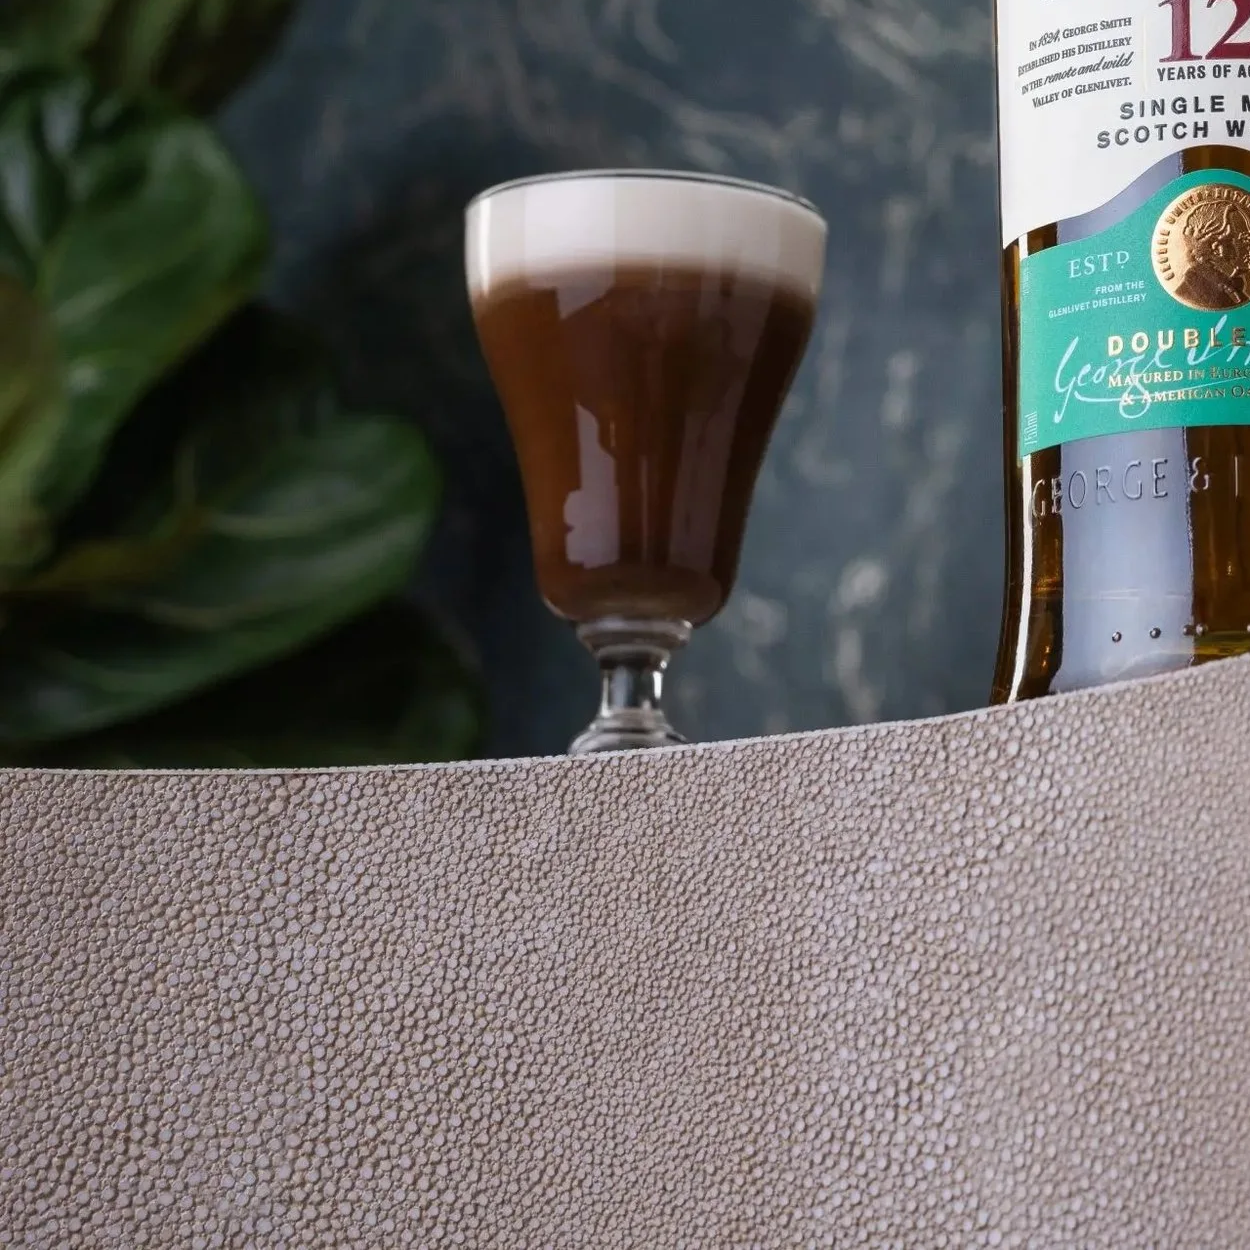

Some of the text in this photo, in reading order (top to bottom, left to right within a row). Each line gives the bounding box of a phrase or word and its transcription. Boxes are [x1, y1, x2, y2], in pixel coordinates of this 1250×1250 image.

[1029, 41, 1037, 51] IN
[1062, 23, 1098, 39] GEORGE
[1100, 17, 1132, 30] SMITH
[1018, 36, 1132, 77] ESTABLISHED HIS DISTILLERY
[1030, 78, 1043, 90] THE
[1044, 66, 1077, 85] remote
[1078, 56, 1105, 75] and
[1102, 51, 1134, 70] wild
[1156, 64, 1206, 81] YEARS
[1212, 64, 1232, 79] OF
[1032, 77, 1132, 108] VALLEY OF GLENLIVET.
[1119, 95, 1225, 120] SINGLE
[1097, 121, 1208, 148] SCOTCH
[1095, 280, 1145, 295] FROM THE
[1048, 293, 1147, 319] GLENLIVET DISTILLERY
[1107, 326, 1247, 357] DOUBLE
[1108, 370, 1183, 388] MATURED
[1188, 368, 1205, 380] IN
[1141, 387, 1227, 405] AMERICAN
[1031, 458, 1168, 518] GEORGE
[1190, 457, 1210, 493] &
